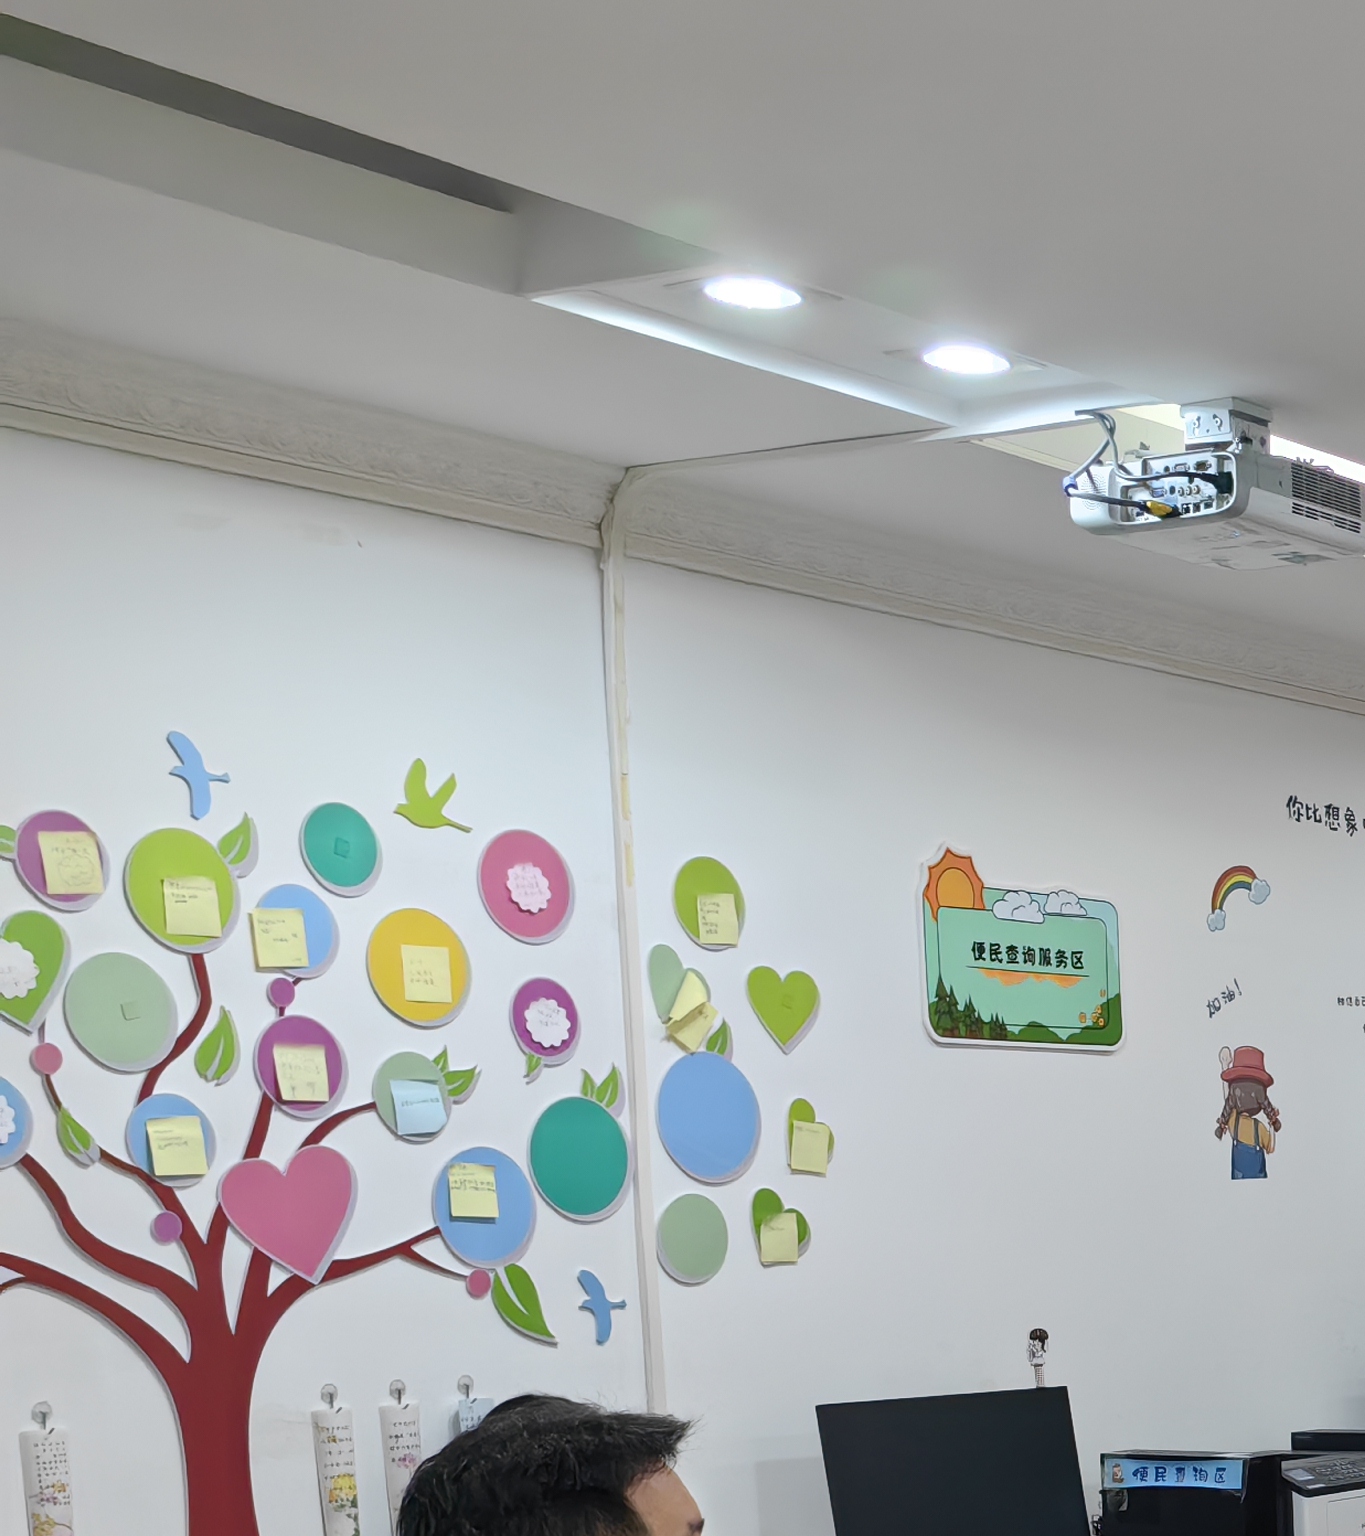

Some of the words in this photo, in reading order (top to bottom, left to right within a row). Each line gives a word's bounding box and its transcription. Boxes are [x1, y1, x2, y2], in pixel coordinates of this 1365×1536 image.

[971, 941, 1085, 970] 便民查询服务区
